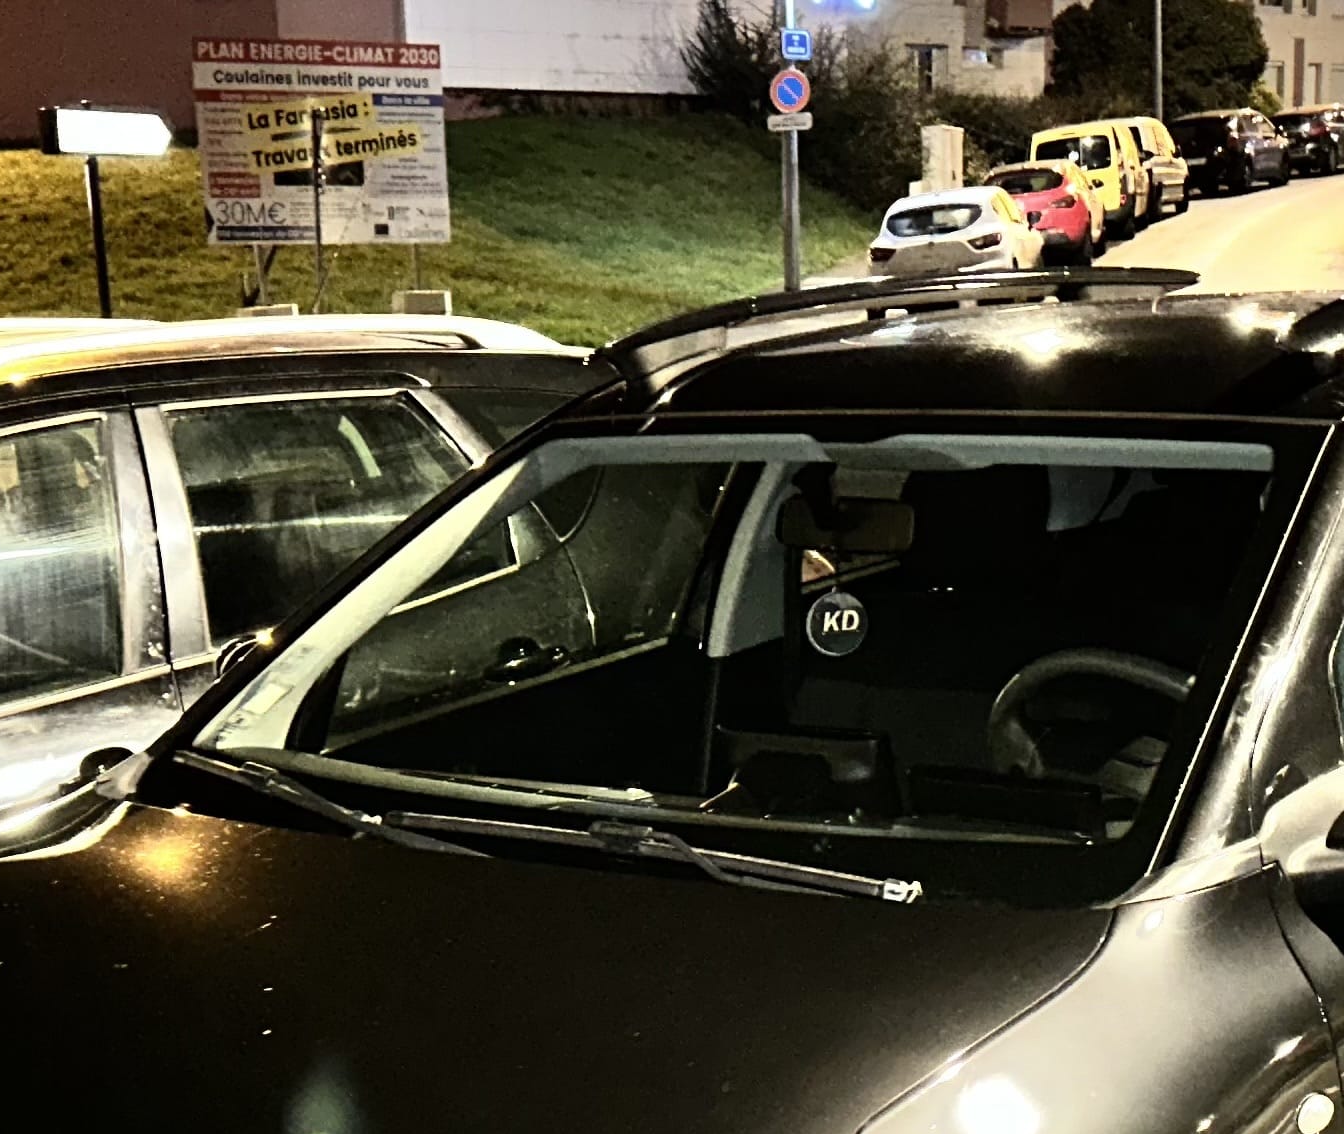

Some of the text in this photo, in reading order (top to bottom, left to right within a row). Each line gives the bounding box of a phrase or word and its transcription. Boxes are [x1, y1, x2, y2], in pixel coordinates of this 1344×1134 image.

[197, 41, 439, 65] PLAN ENERGIE-CLIMAT 2030
[213, 68, 293, 85] Coulaines
[358, 75, 391, 91] pour
[396, 76, 430, 89] vous
[247, 112, 270, 130] La
[335, 129, 418, 157] terminés
[215, 200, 287, 225] 30M€
[823, 609, 860, 633] KD
